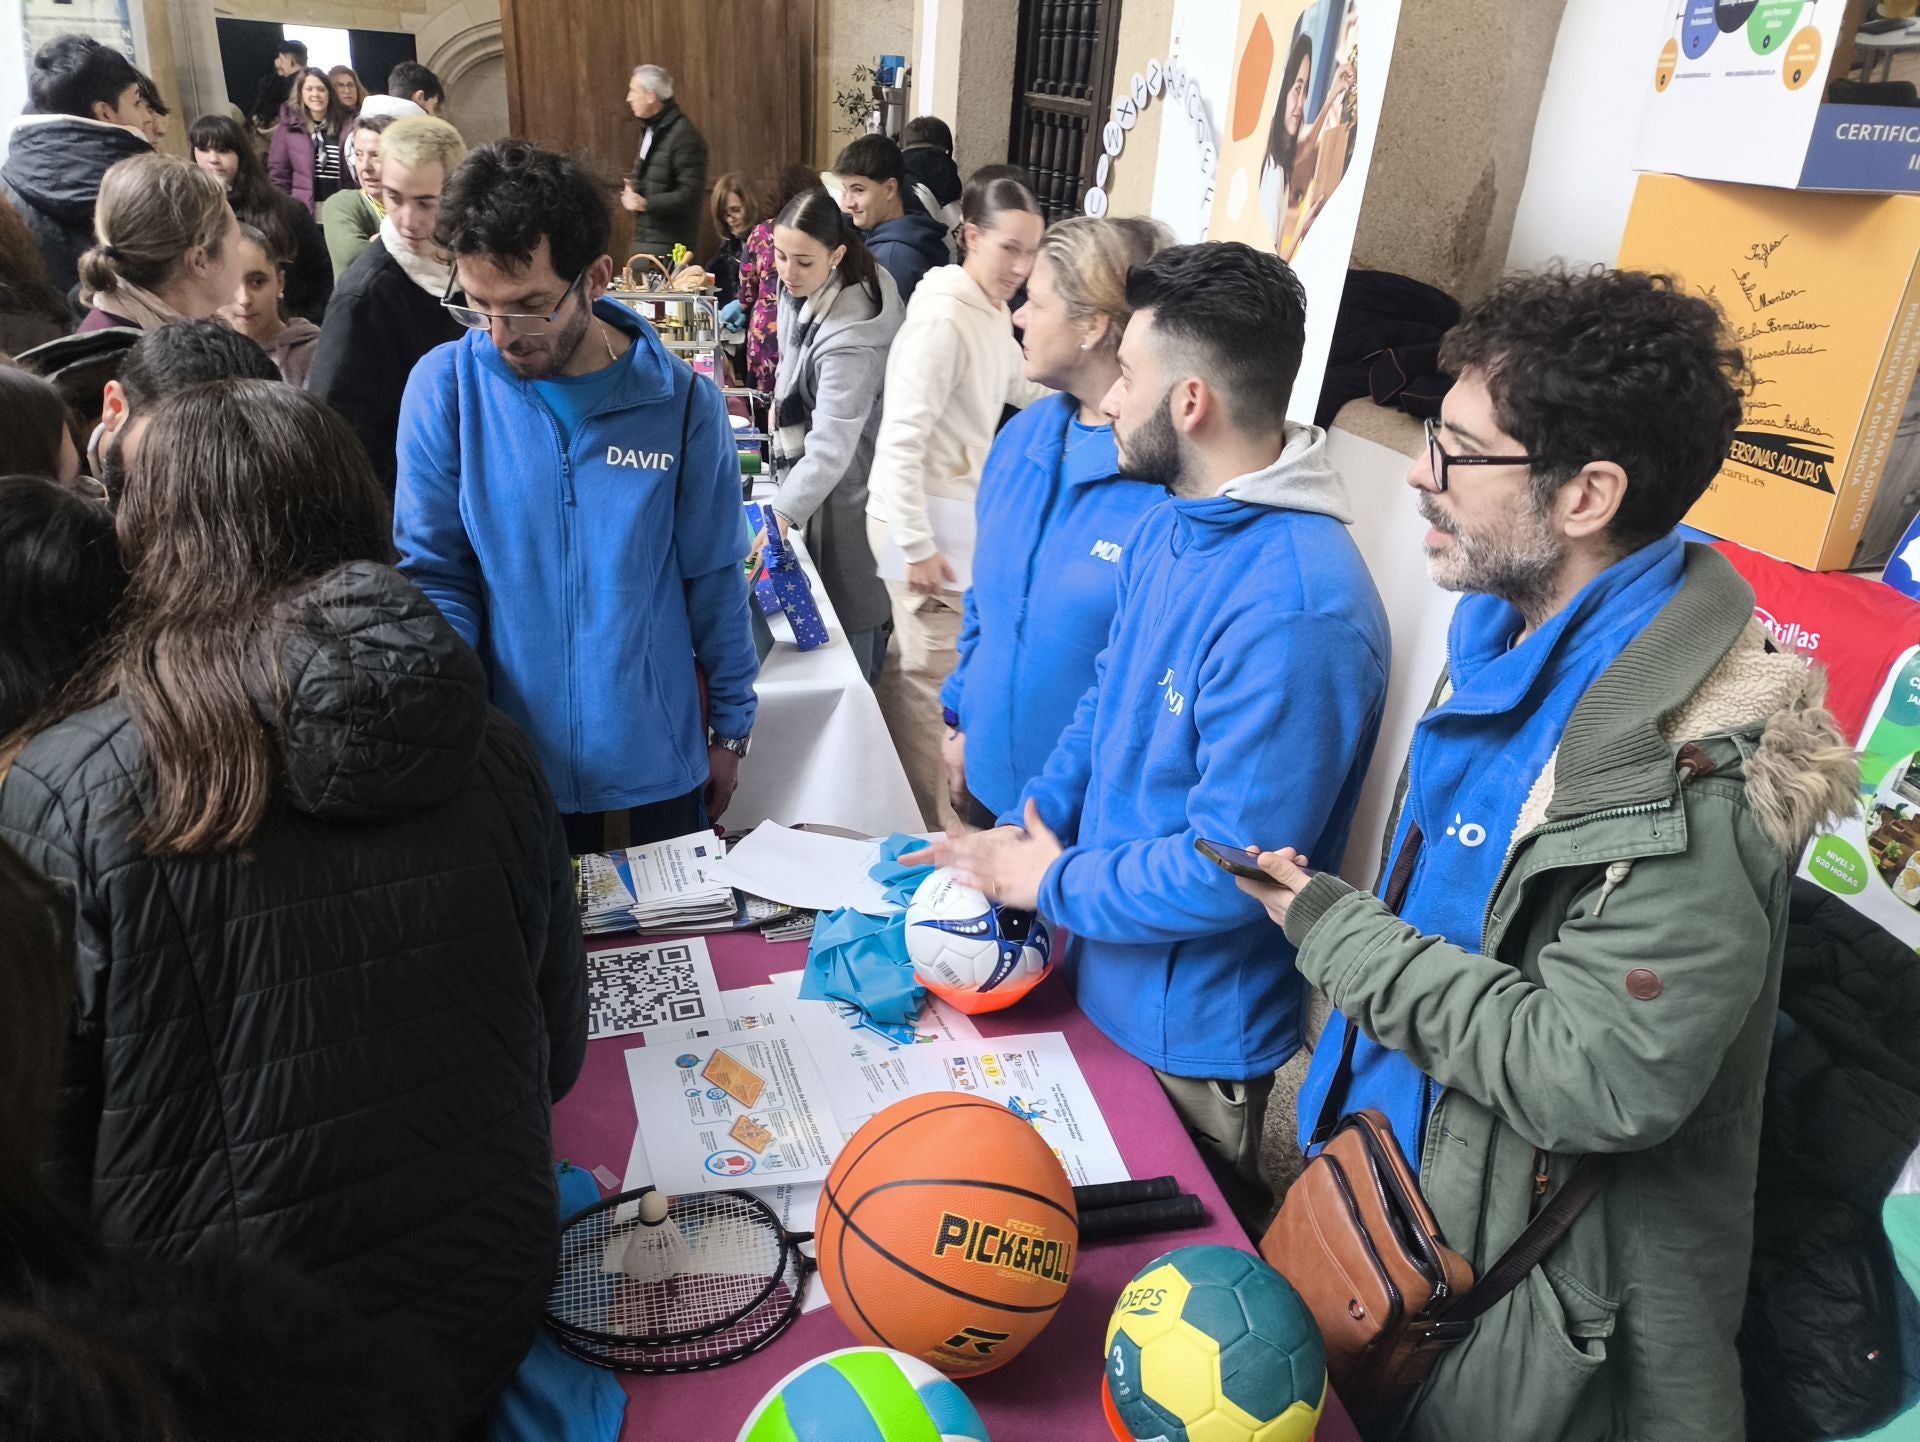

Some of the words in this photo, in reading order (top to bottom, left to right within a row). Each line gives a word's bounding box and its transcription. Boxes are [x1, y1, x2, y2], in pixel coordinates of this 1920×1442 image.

[1747, 340, 1828, 368] fesionalidad
[1884, 302, 1920, 385] PRESENCIAL
[1875, 402, 1886, 412] A
[606, 445, 675, 472] DAVID
[1730, 439, 1778, 470] ERSONAS
[1776, 454, 1823, 484] ADULTAS
[1850, 415, 1882, 487] DISTANCIA
[1872, 431, 1890, 467] PARA
[1850, 470, 1877, 531] ADULTOS
[932, 1210, 1073, 1286] PICK&ROLL
[1113, 1345, 1125, 1377] 3
